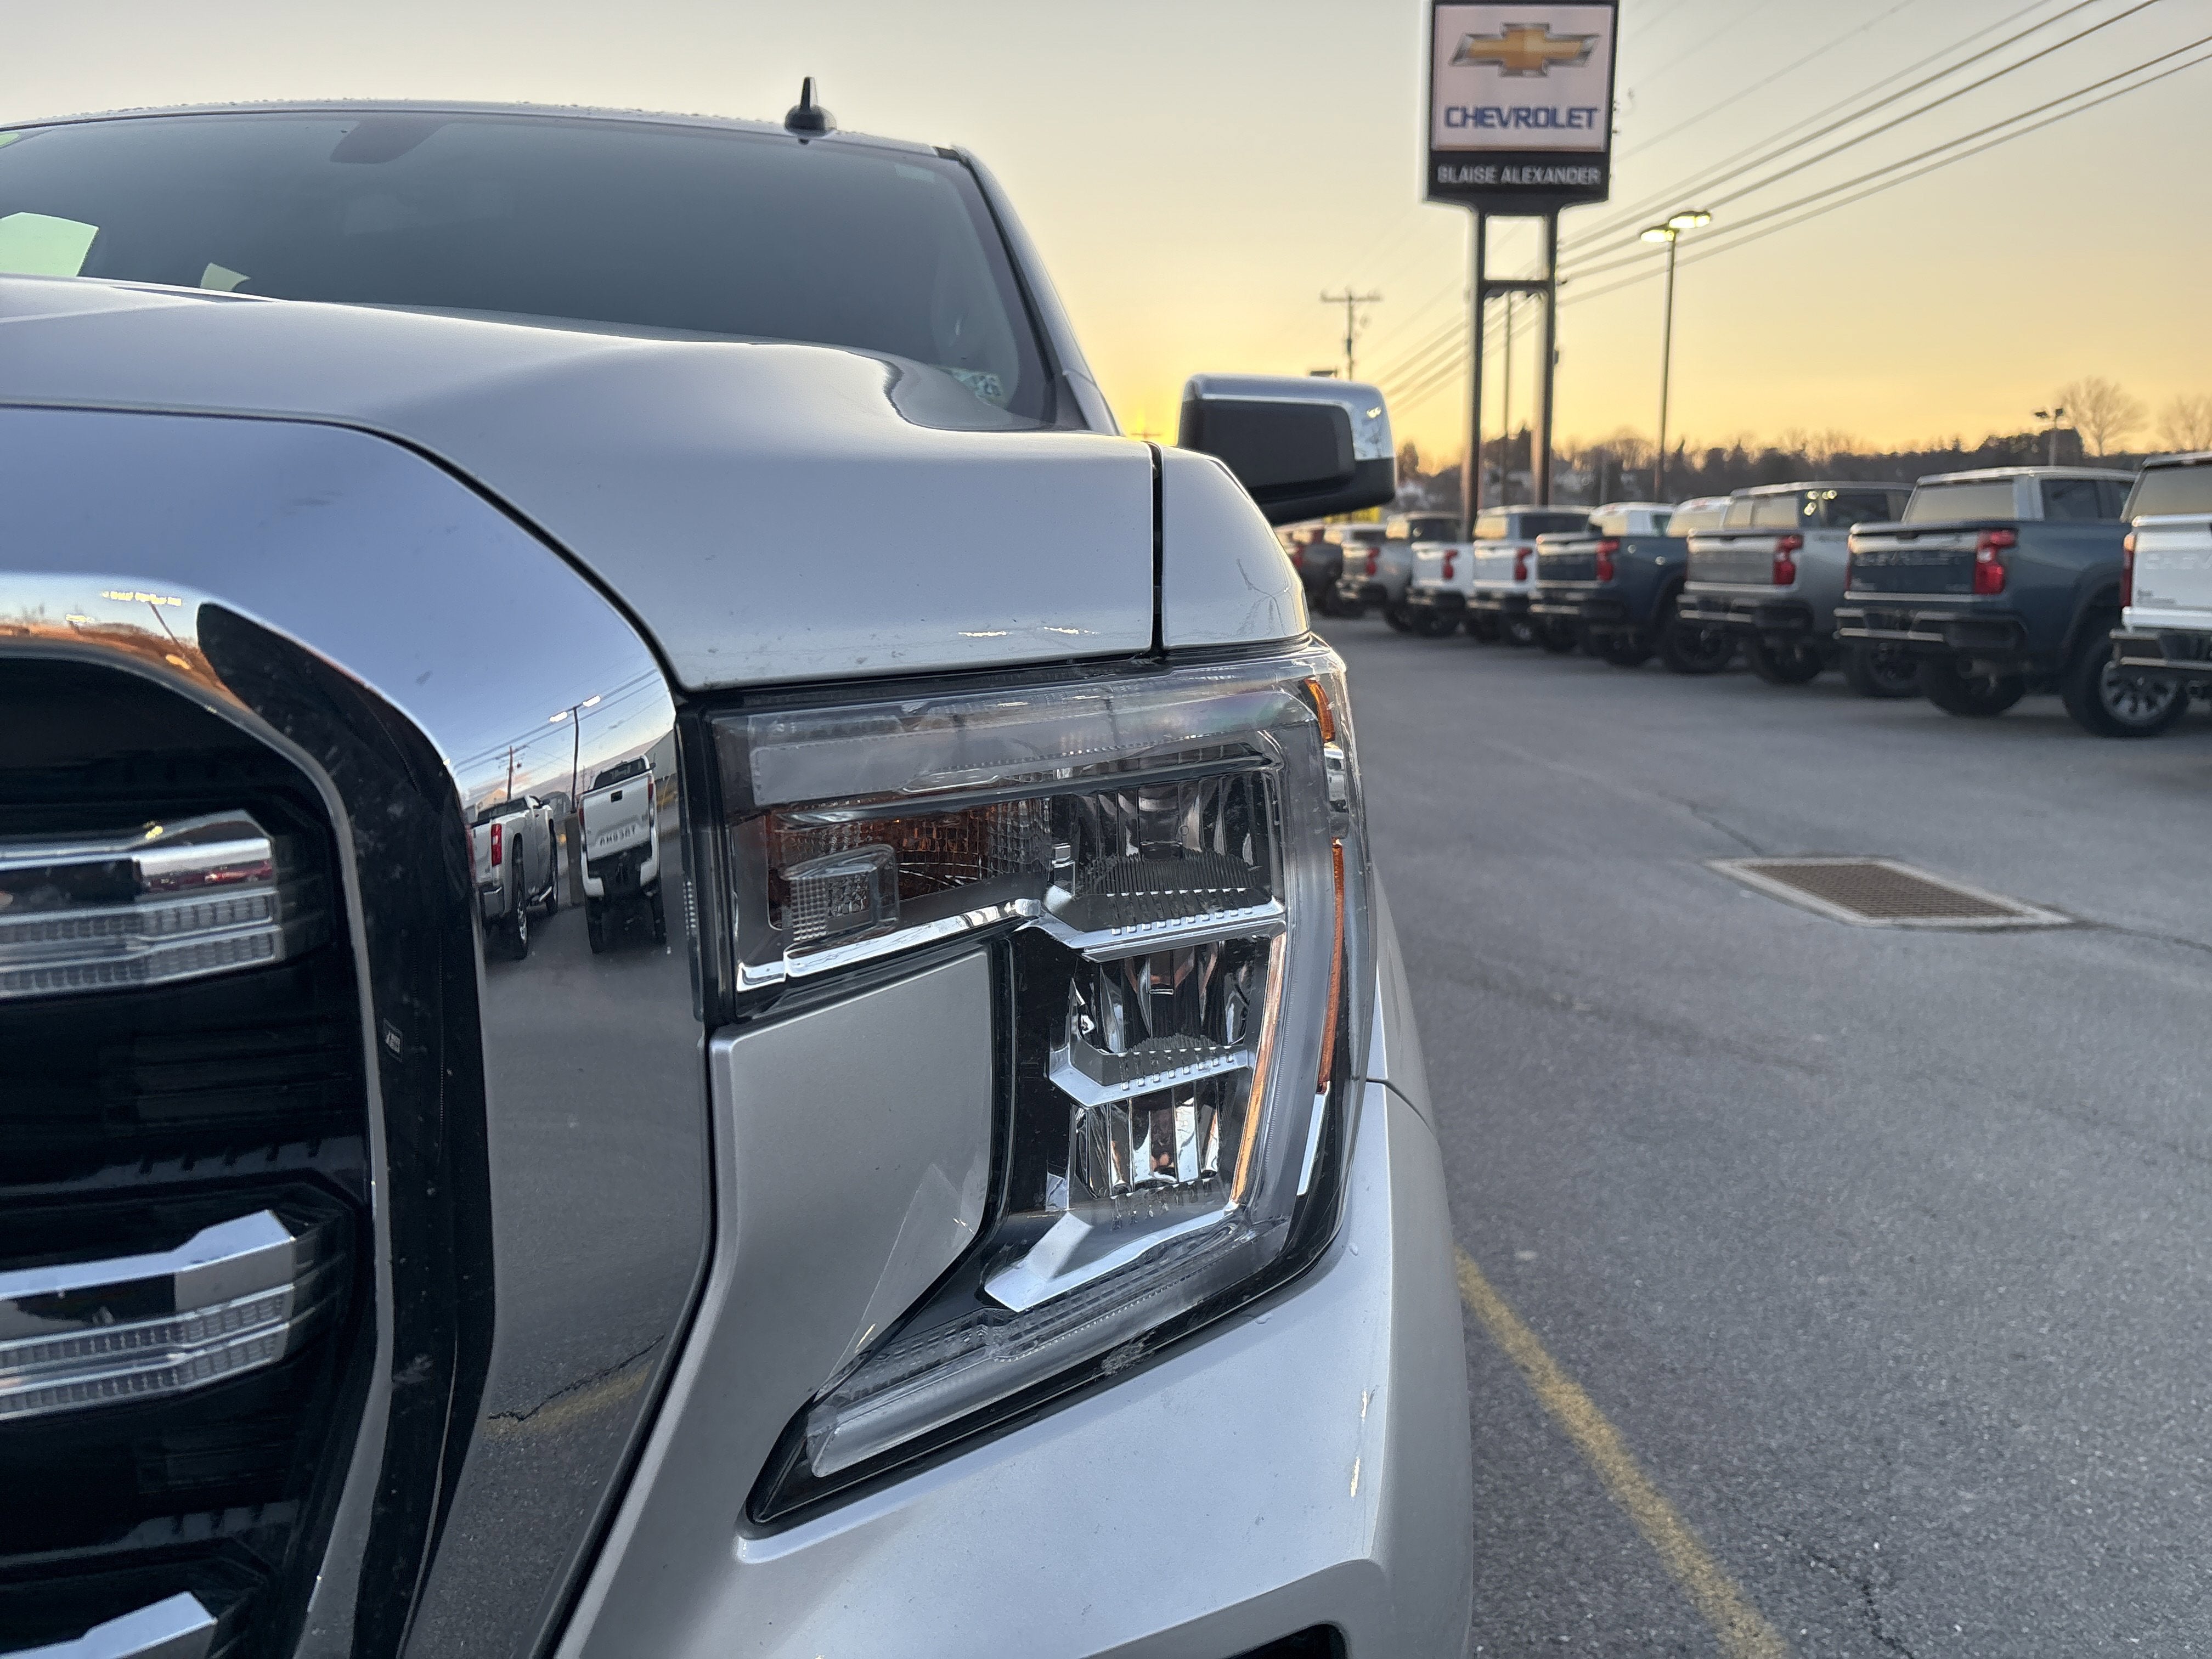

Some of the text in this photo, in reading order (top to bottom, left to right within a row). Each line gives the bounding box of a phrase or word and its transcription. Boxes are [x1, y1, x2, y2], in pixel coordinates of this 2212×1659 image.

[1445, 107, 1599, 129] CHEVROLET
[1437, 165, 1601, 185] BLAISE ALEXANDER
